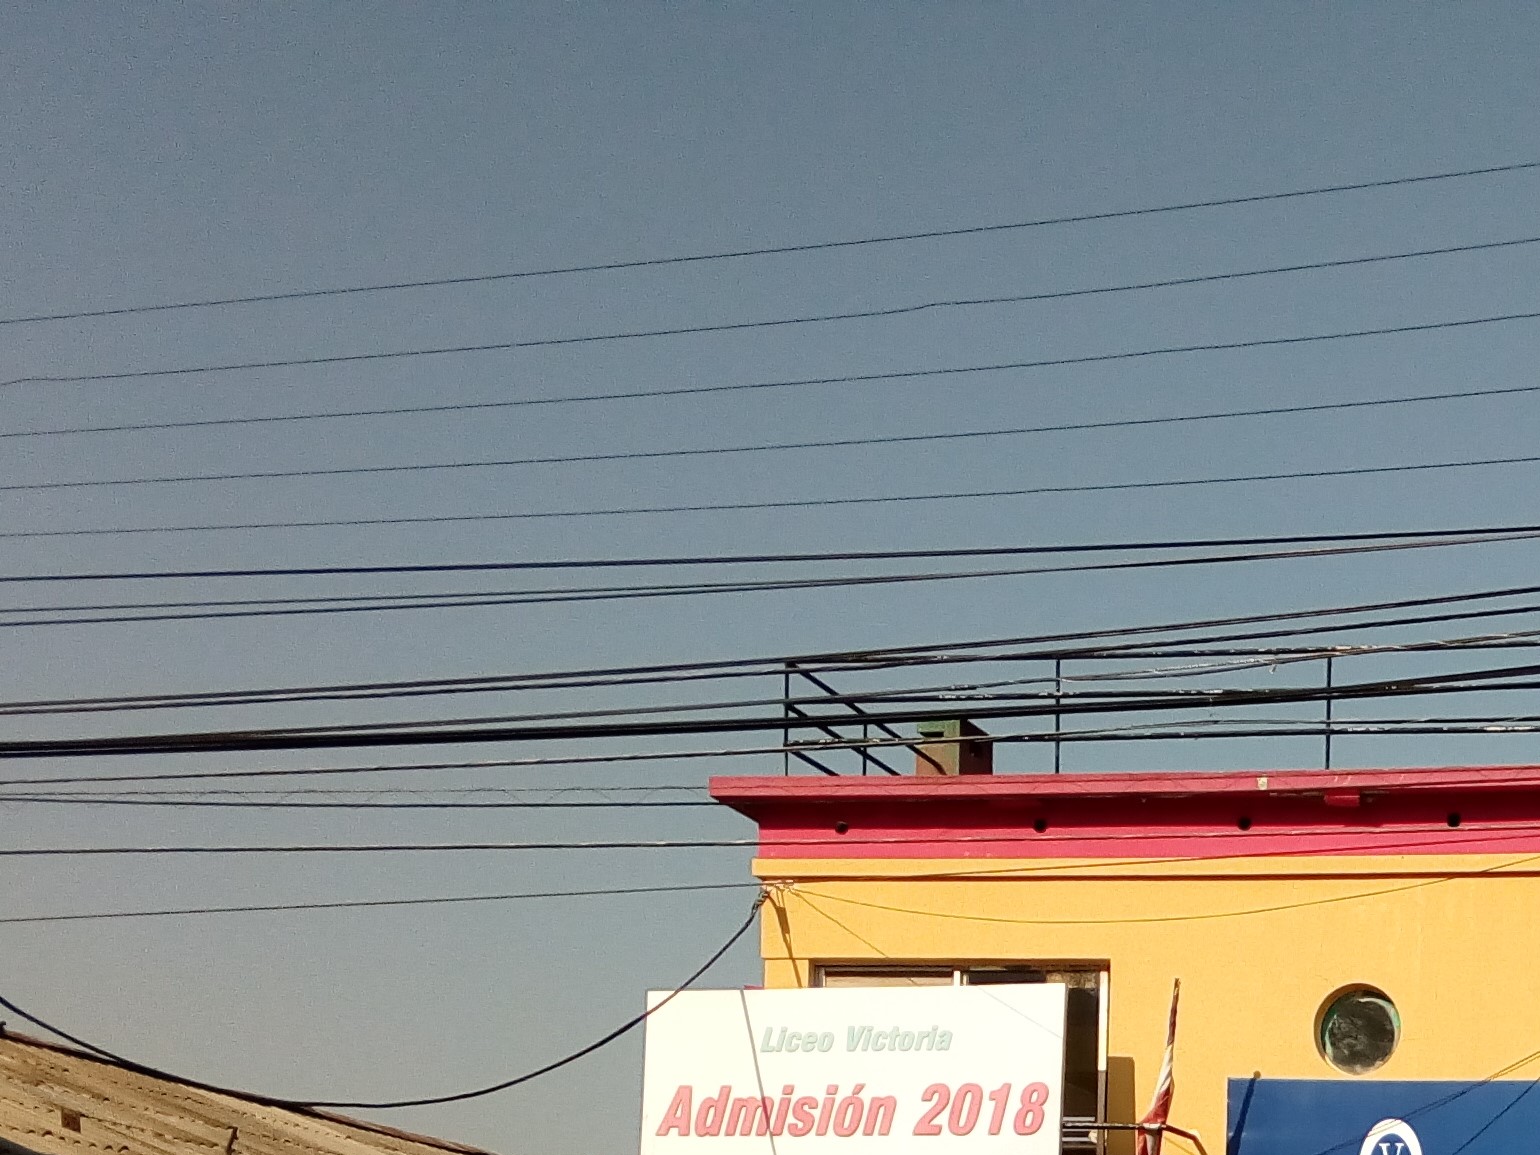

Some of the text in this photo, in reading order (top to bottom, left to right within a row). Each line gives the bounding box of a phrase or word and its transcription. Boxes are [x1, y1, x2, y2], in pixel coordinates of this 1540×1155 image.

[760, 1025, 953, 1053] Liceo Victoria
[655, 1081, 1050, 1137] Admisión 2018
